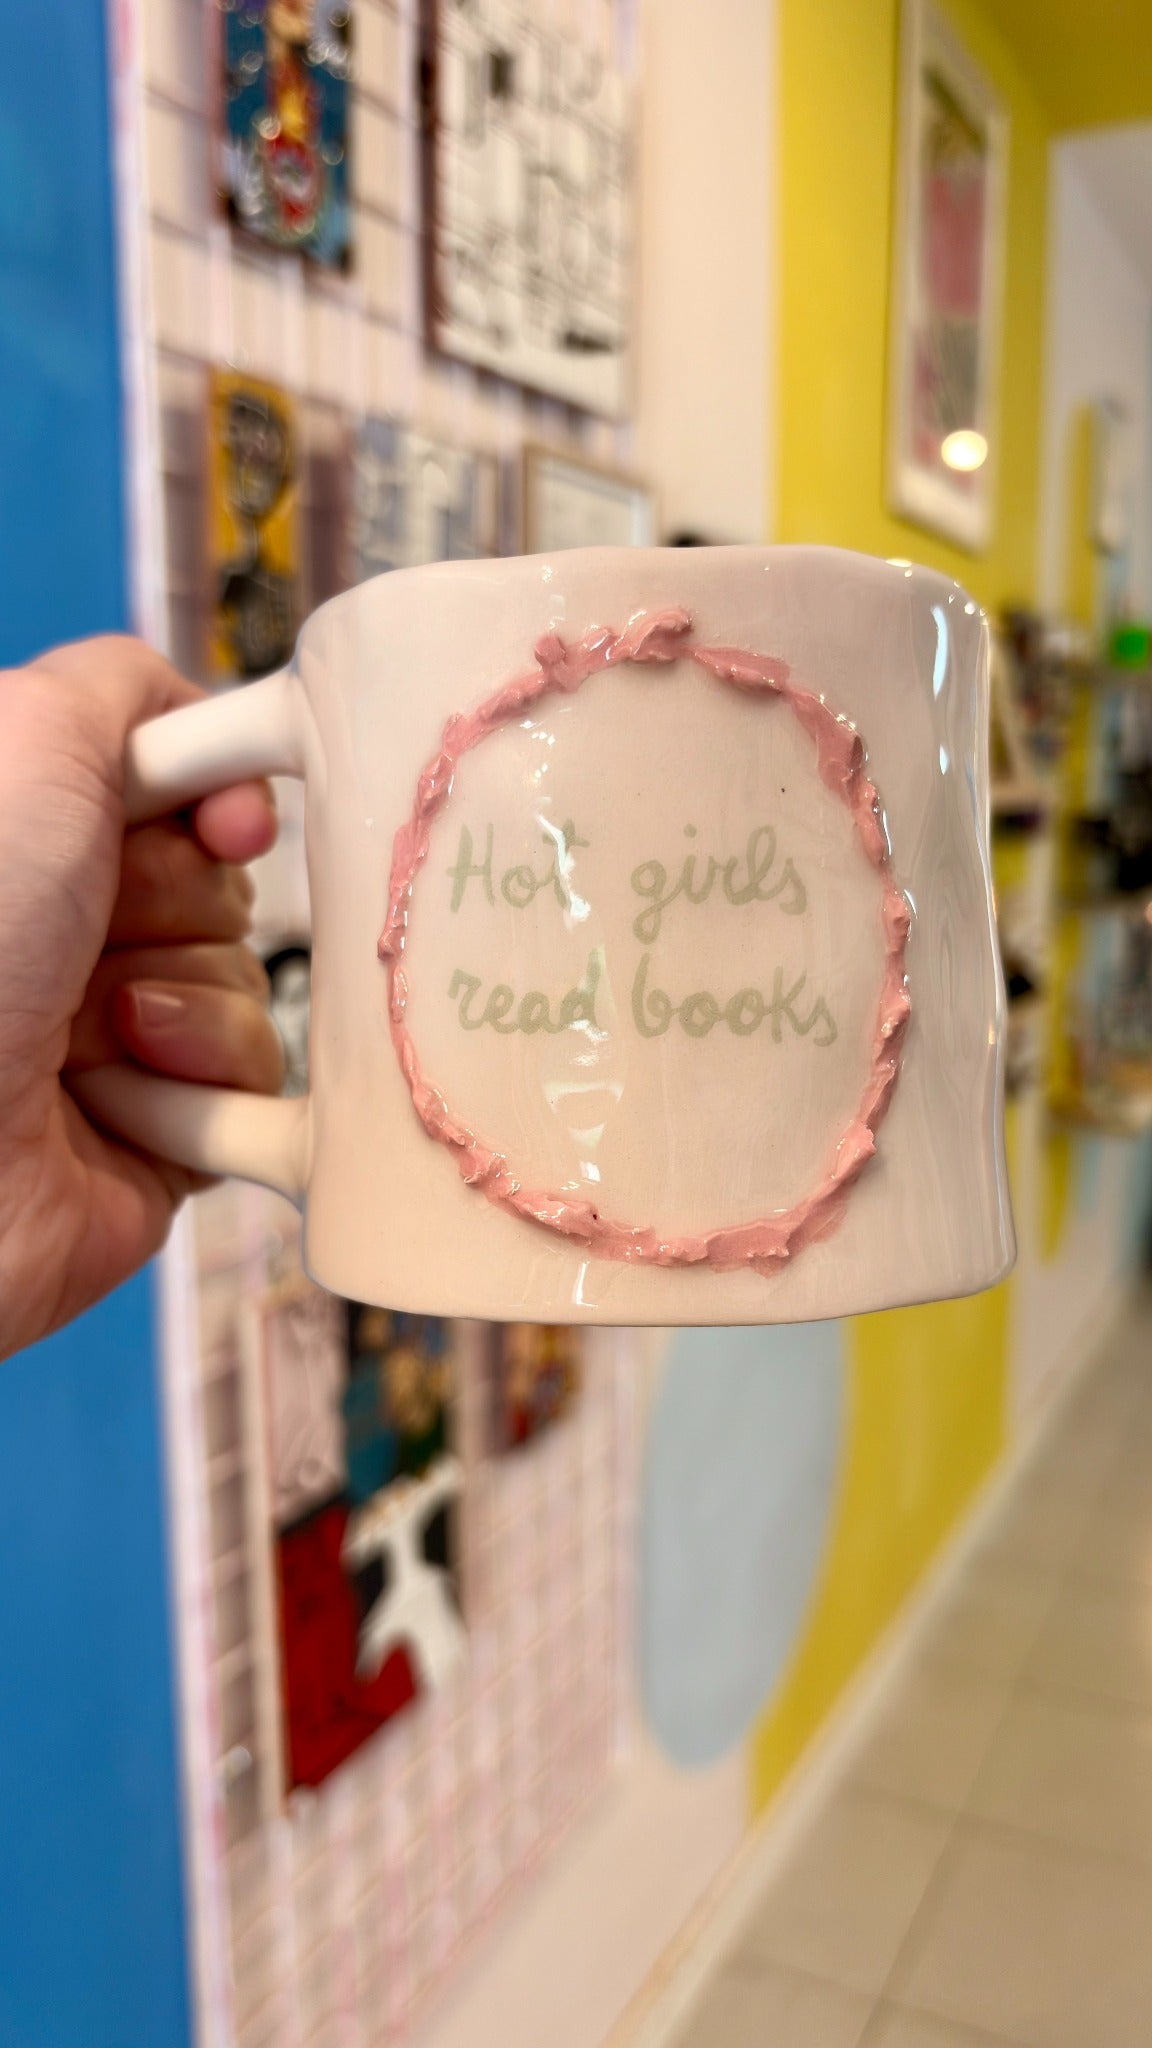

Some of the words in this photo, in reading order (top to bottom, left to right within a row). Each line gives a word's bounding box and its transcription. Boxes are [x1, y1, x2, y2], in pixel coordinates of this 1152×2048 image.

[447, 820, 590, 913] Hot
[630, 823, 808, 945] girls
[447, 945, 605, 1035] read
[630, 953, 838, 1047] books
